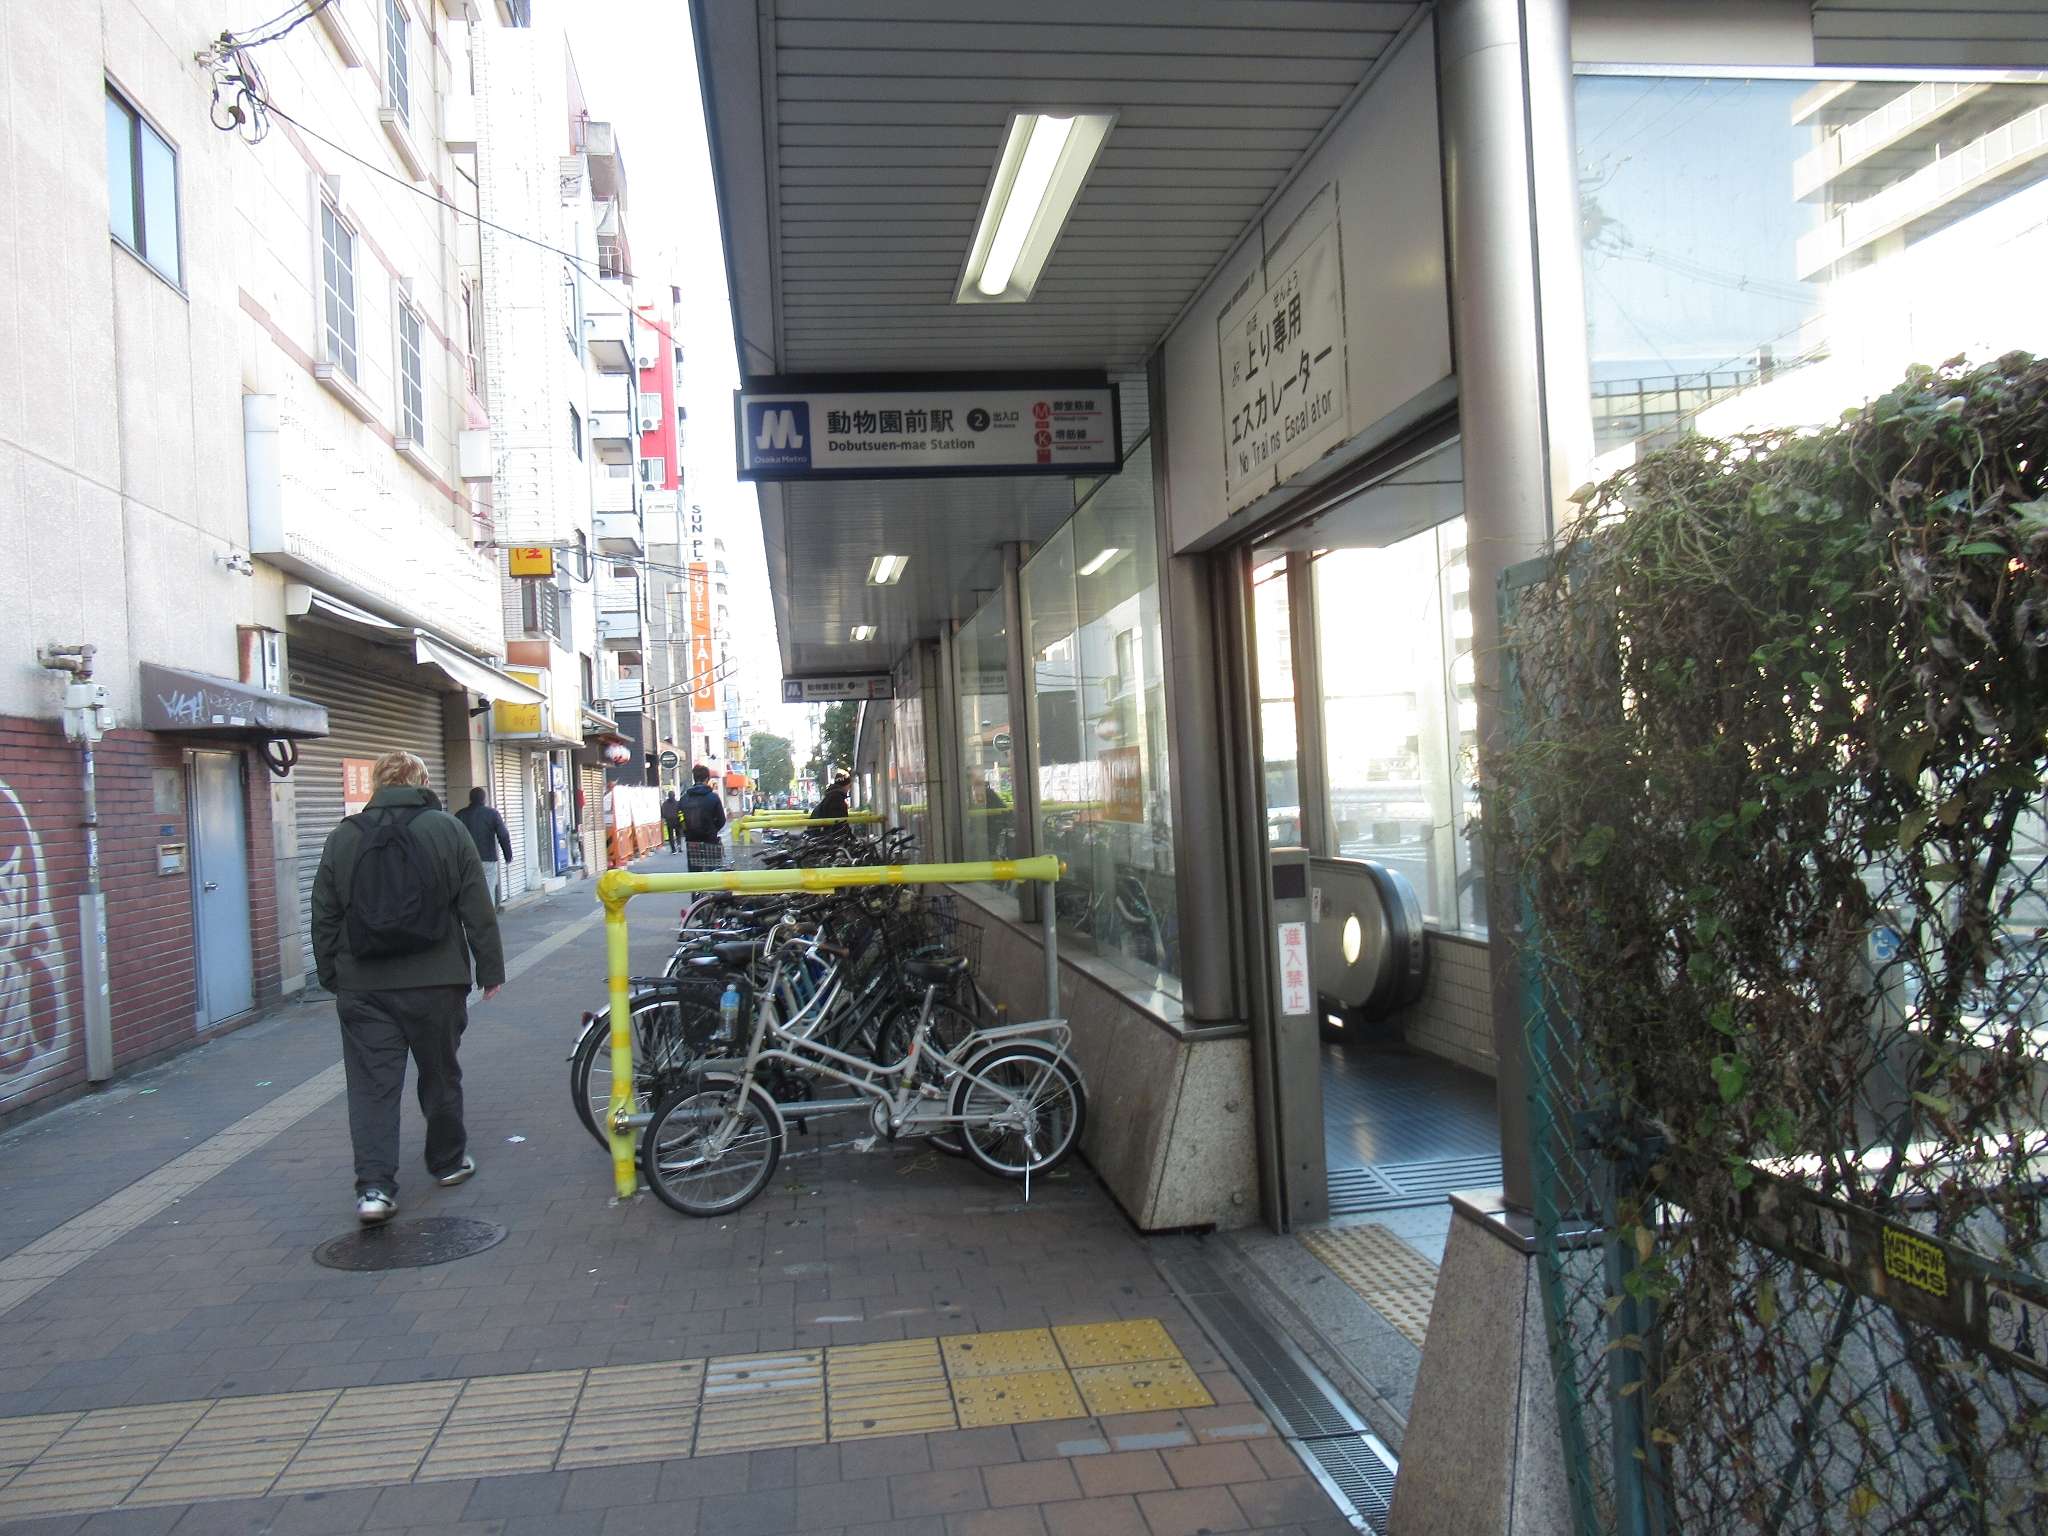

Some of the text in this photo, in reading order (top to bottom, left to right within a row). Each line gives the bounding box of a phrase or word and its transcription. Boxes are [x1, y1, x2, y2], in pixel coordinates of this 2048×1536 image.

[1245, 292, 1301, 382] 上り専用
[827, 408, 954, 434] 動物園前駅
[1232, 345, 1333, 446] エスカレーター
[1252, 431, 1280, 468] Trains
[1285, 390, 1332, 443] Escalator
[828, 438, 975, 452] Dobutsuen-mae Station
[691, 505, 703, 561] SUN PL
[694, 575, 711, 698] HOTEL TAIYO
[1284, 927, 1305, 1009] 進入禁止
